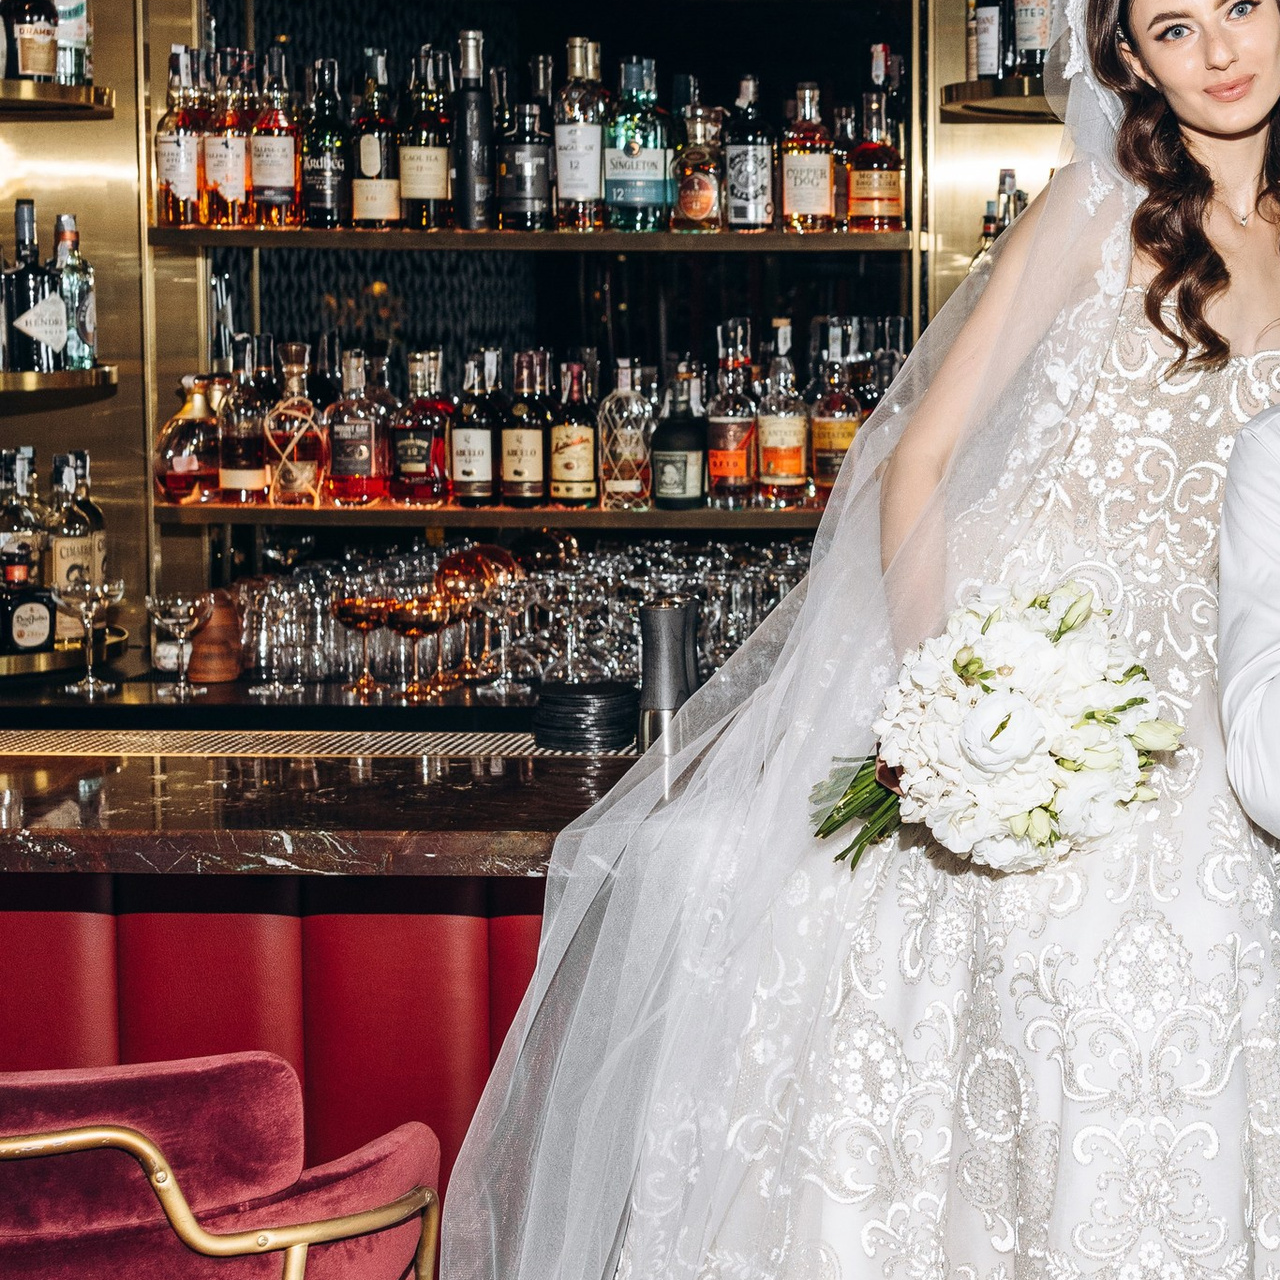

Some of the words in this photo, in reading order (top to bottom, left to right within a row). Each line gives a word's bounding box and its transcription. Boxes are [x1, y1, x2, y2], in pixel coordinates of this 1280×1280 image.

[569, 159, 580, 170] 12
[609, 157, 659, 171] SINGLETON
[786, 168, 828, 180] COPPER
[793, 177, 820, 187] DOG
[612, 187, 625, 201] 12
[455, 449, 485, 457] ABUELO
[506, 449, 537, 457] ABUELO
